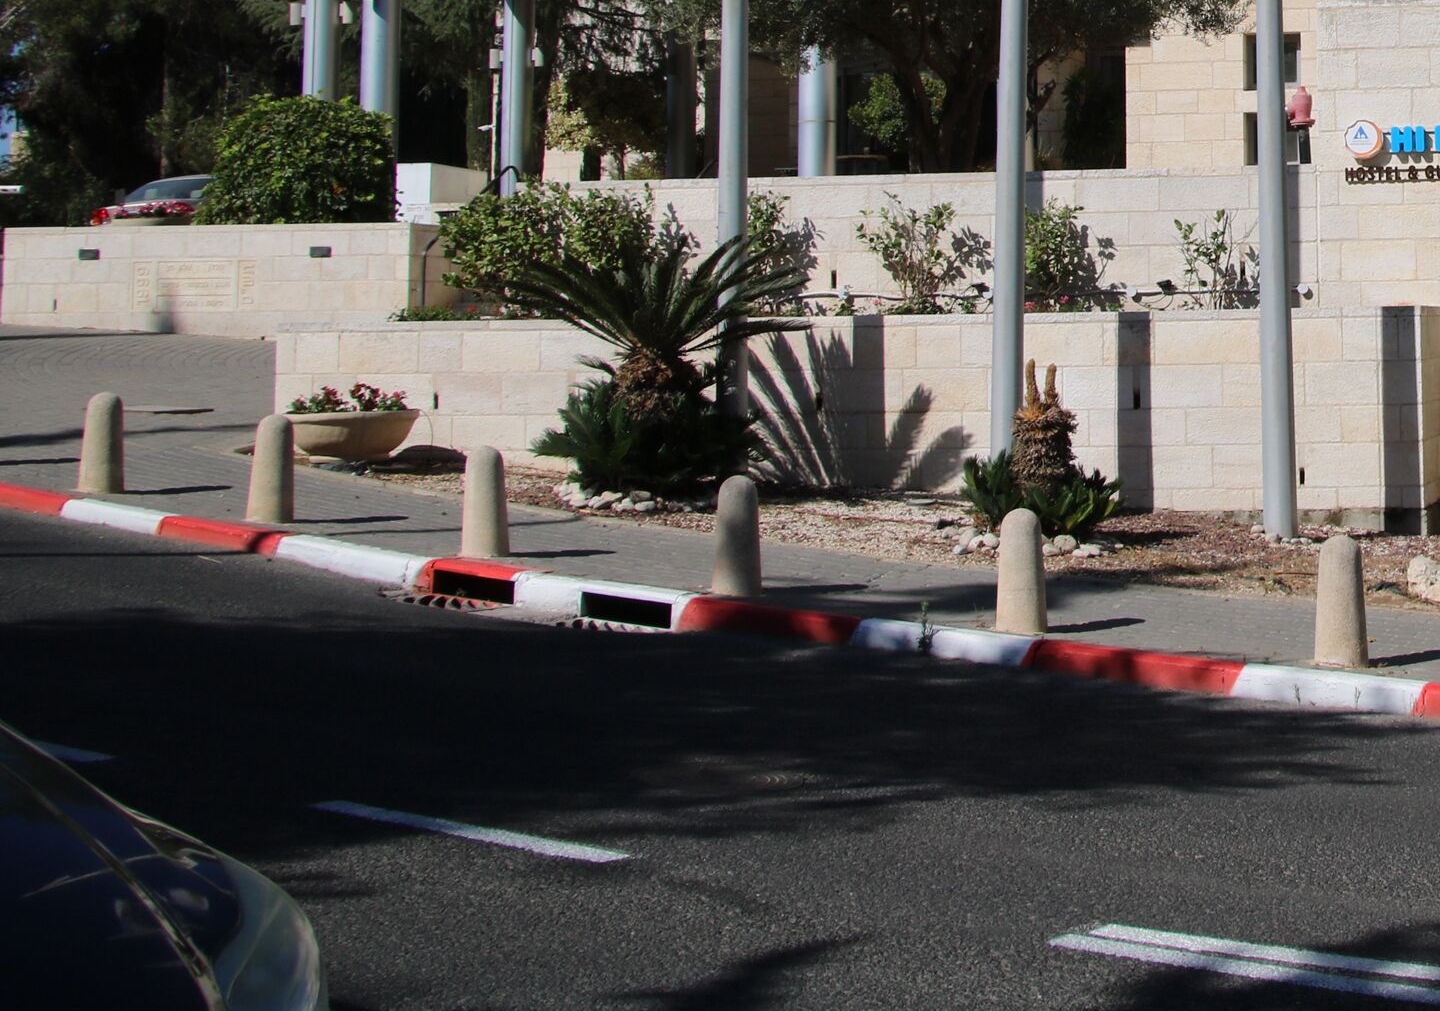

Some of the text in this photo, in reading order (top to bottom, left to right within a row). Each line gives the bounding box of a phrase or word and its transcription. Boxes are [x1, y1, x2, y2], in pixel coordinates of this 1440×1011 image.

[1390, 125, 1426, 154] HI
[1345, 166, 1402, 182] HOSTEL
[1408, 165, 1419, 180] &
